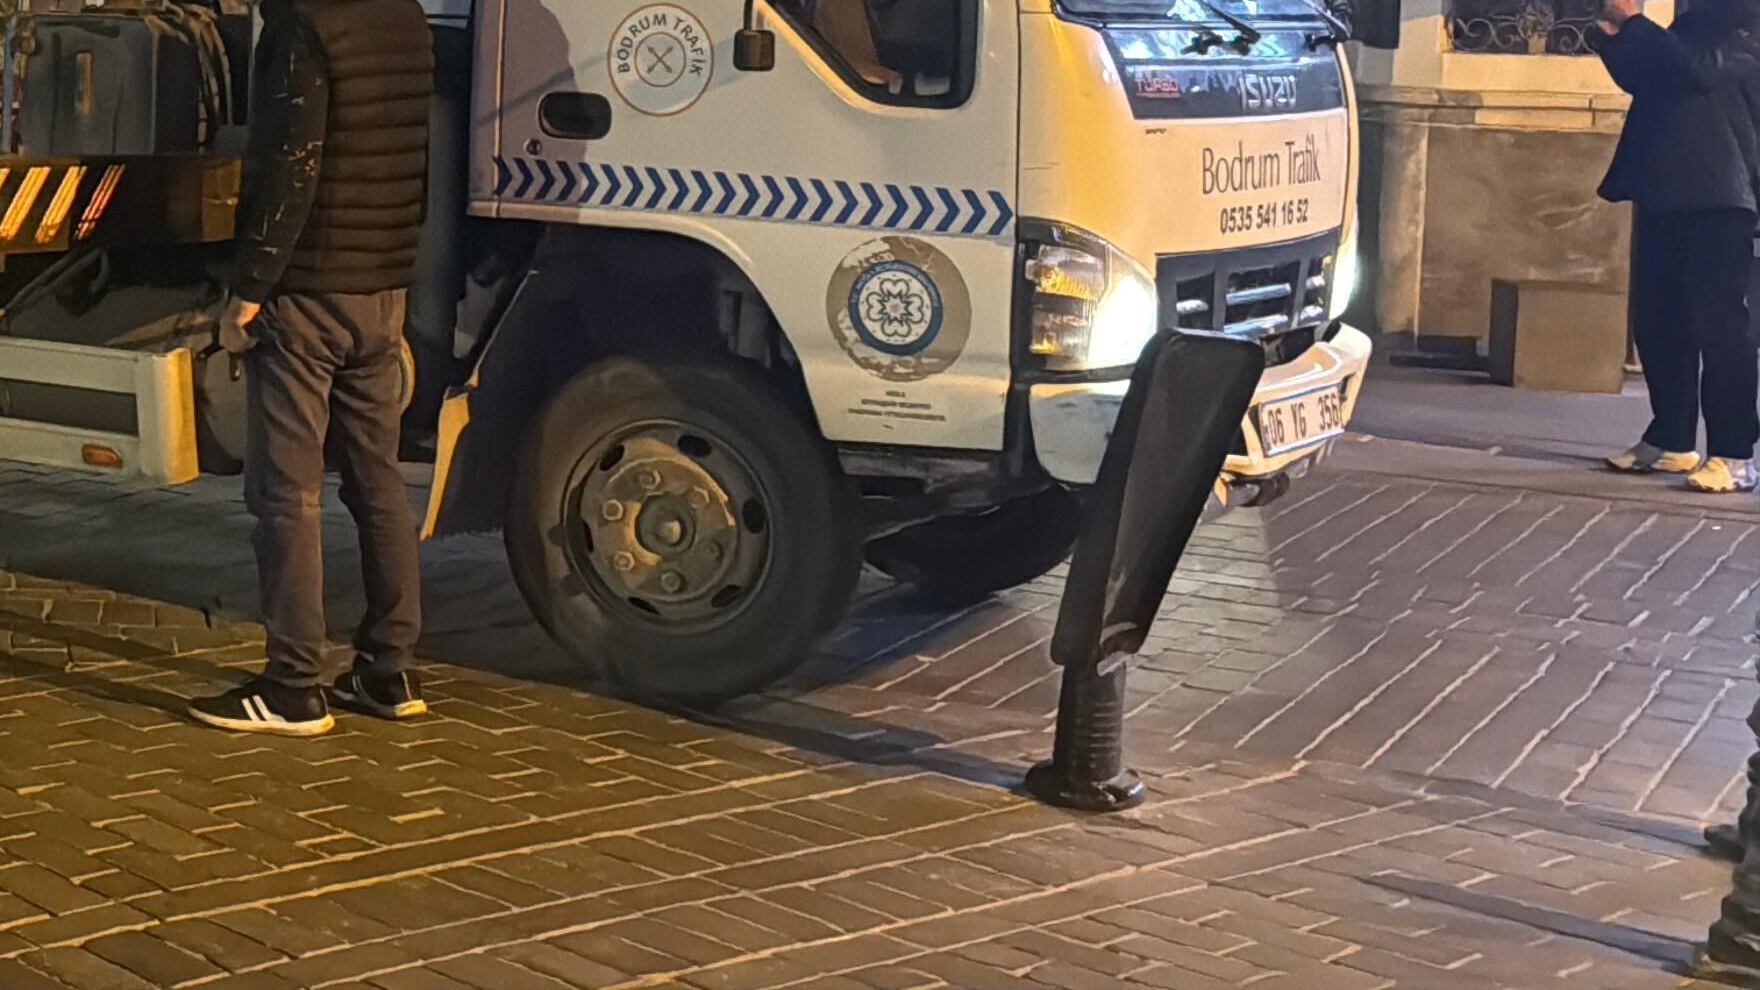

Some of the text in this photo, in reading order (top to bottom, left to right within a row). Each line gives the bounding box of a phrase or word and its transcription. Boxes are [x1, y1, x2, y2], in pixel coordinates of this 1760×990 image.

[617, 13, 668, 74] BODRUM
[1239, 73, 1297, 109] ISUZU
[1202, 141, 1281, 195] Bodrum
[1220, 198, 1309, 234] 0535 541 16 52
[1267, 407, 1285, 446] 06
